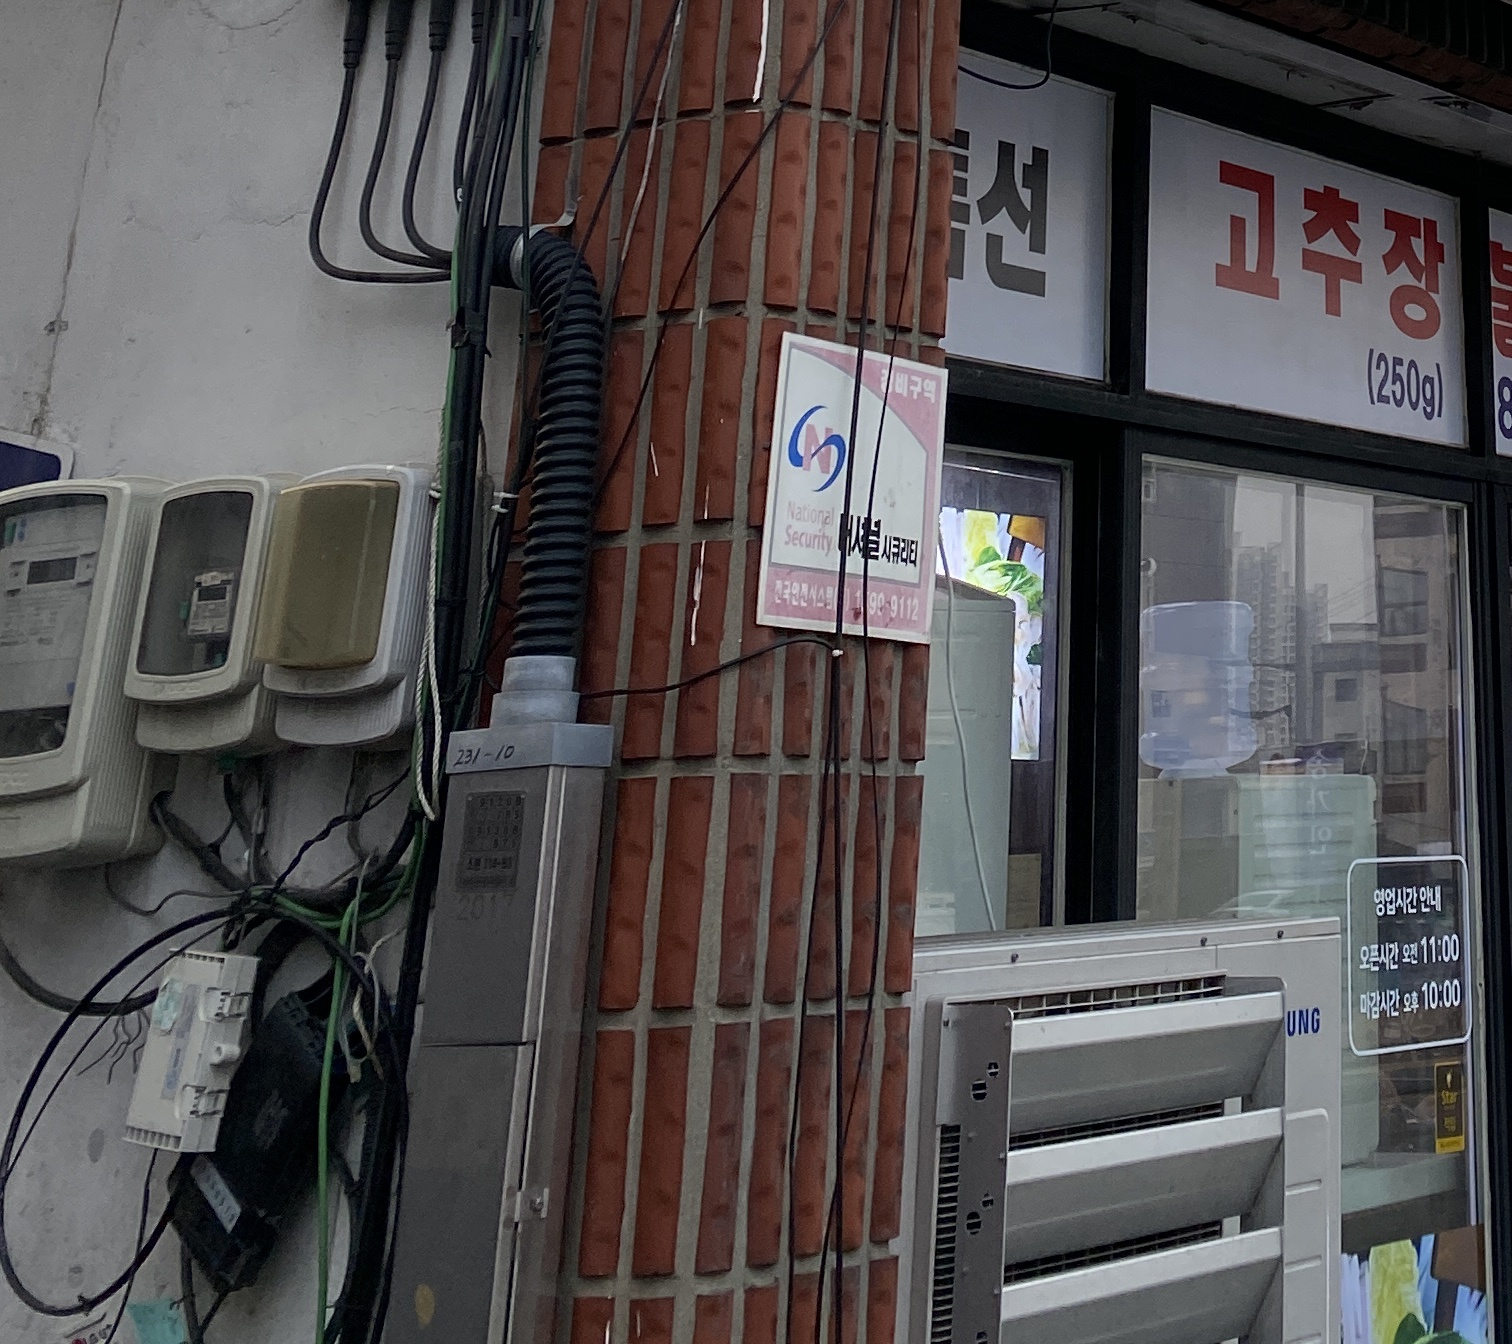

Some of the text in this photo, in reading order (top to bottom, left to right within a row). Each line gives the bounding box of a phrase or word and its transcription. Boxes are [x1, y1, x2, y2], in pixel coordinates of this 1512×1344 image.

[1215, 160, 1447, 340] 고추장
[1367, 347, 1445, 419] (250g)
[786, 499, 836, 528] National
[783, 523, 834, 558] Security
[854, 589, 919, 621] 199-9112
[453, 744, 515, 768] 231-10
[1373, 885, 1443, 917] 영업시간 안내
[1358, 942, 1400, 972] 오픈시간
[1420, 933, 1461, 965] 11:00
[1359, 988, 1401, 1021] 마감시간
[1421, 978, 1462, 1010] 10:00
